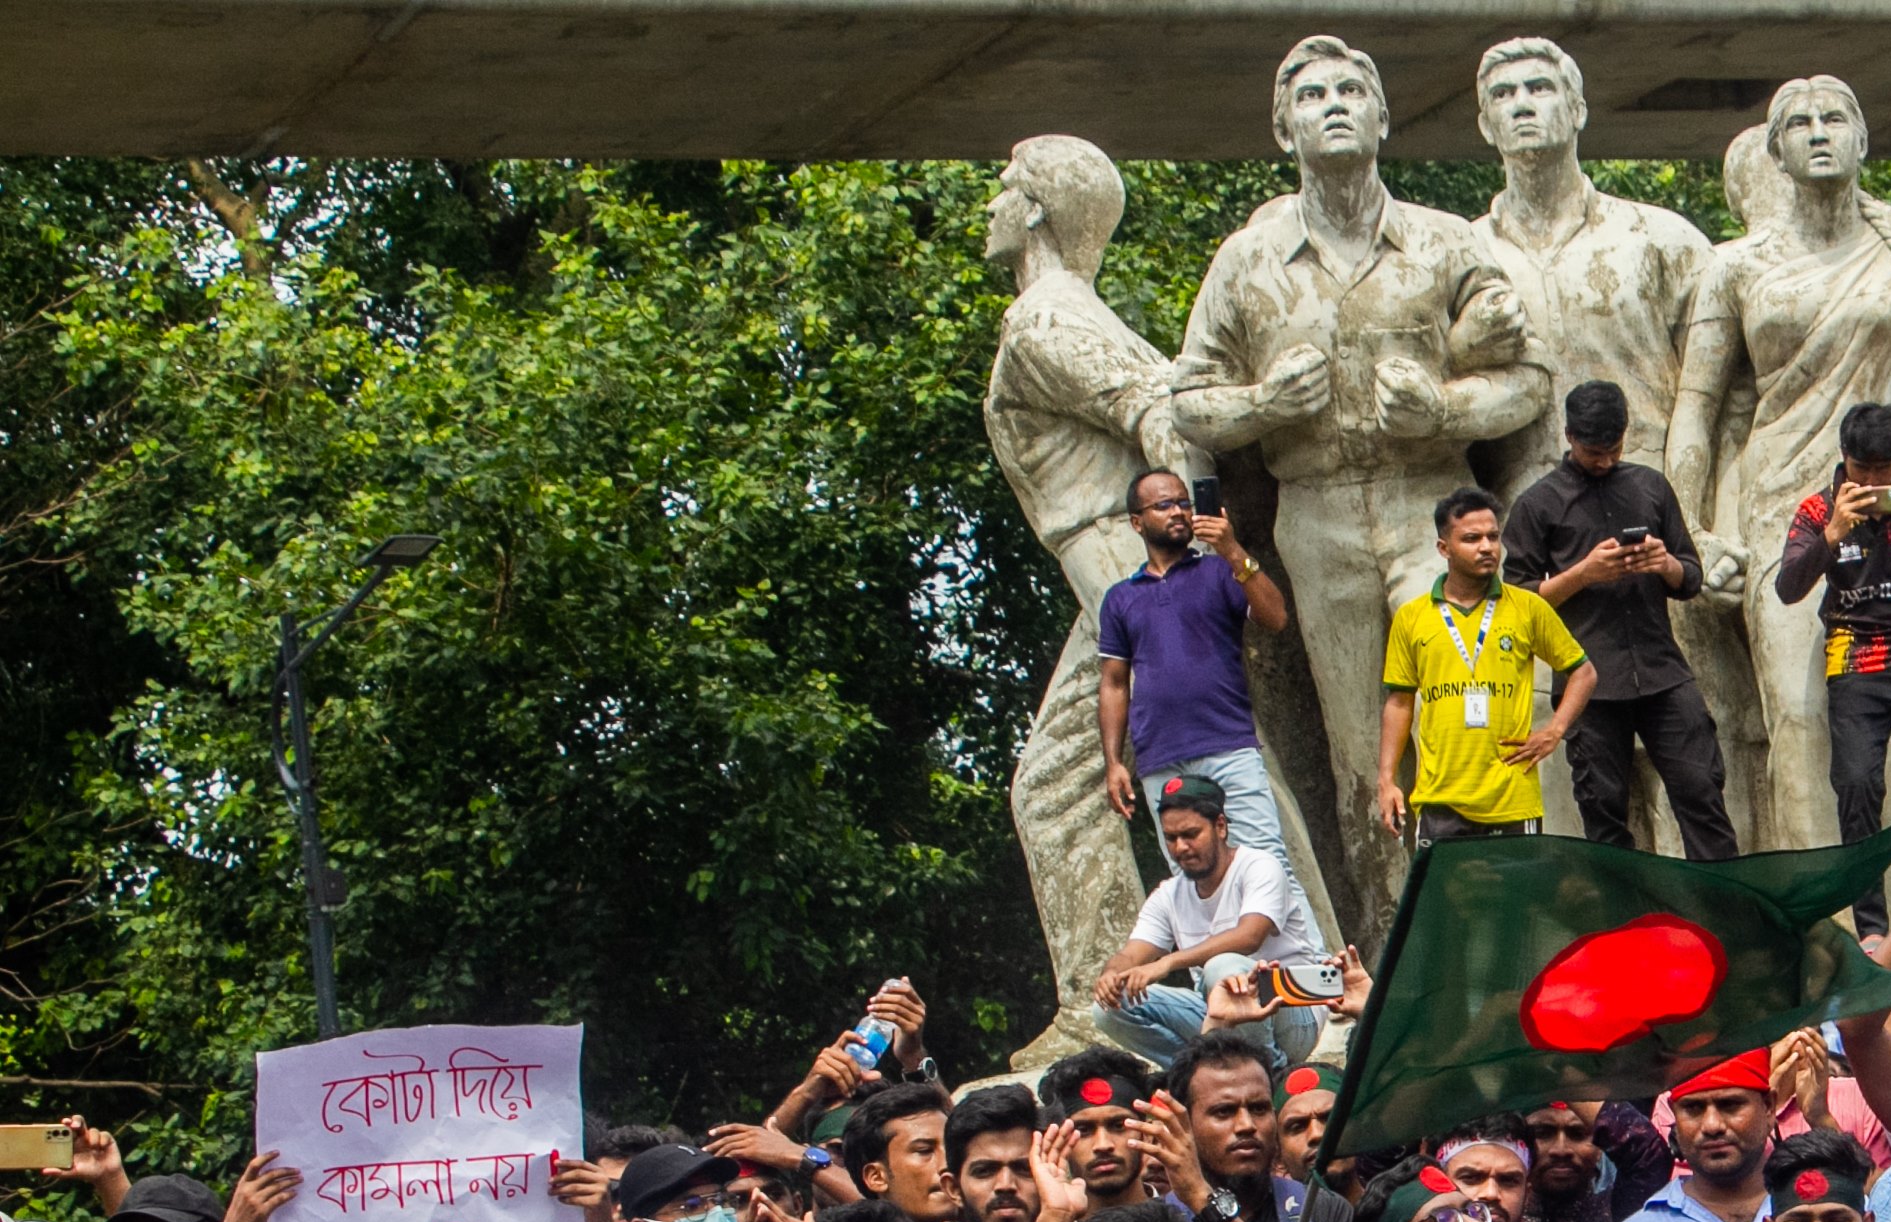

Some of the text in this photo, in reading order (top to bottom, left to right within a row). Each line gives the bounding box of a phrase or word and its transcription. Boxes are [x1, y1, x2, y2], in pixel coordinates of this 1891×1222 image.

[322, 1047, 544, 1133] কোটা দিয়ে
[466, 1153, 536, 1199] নয়
